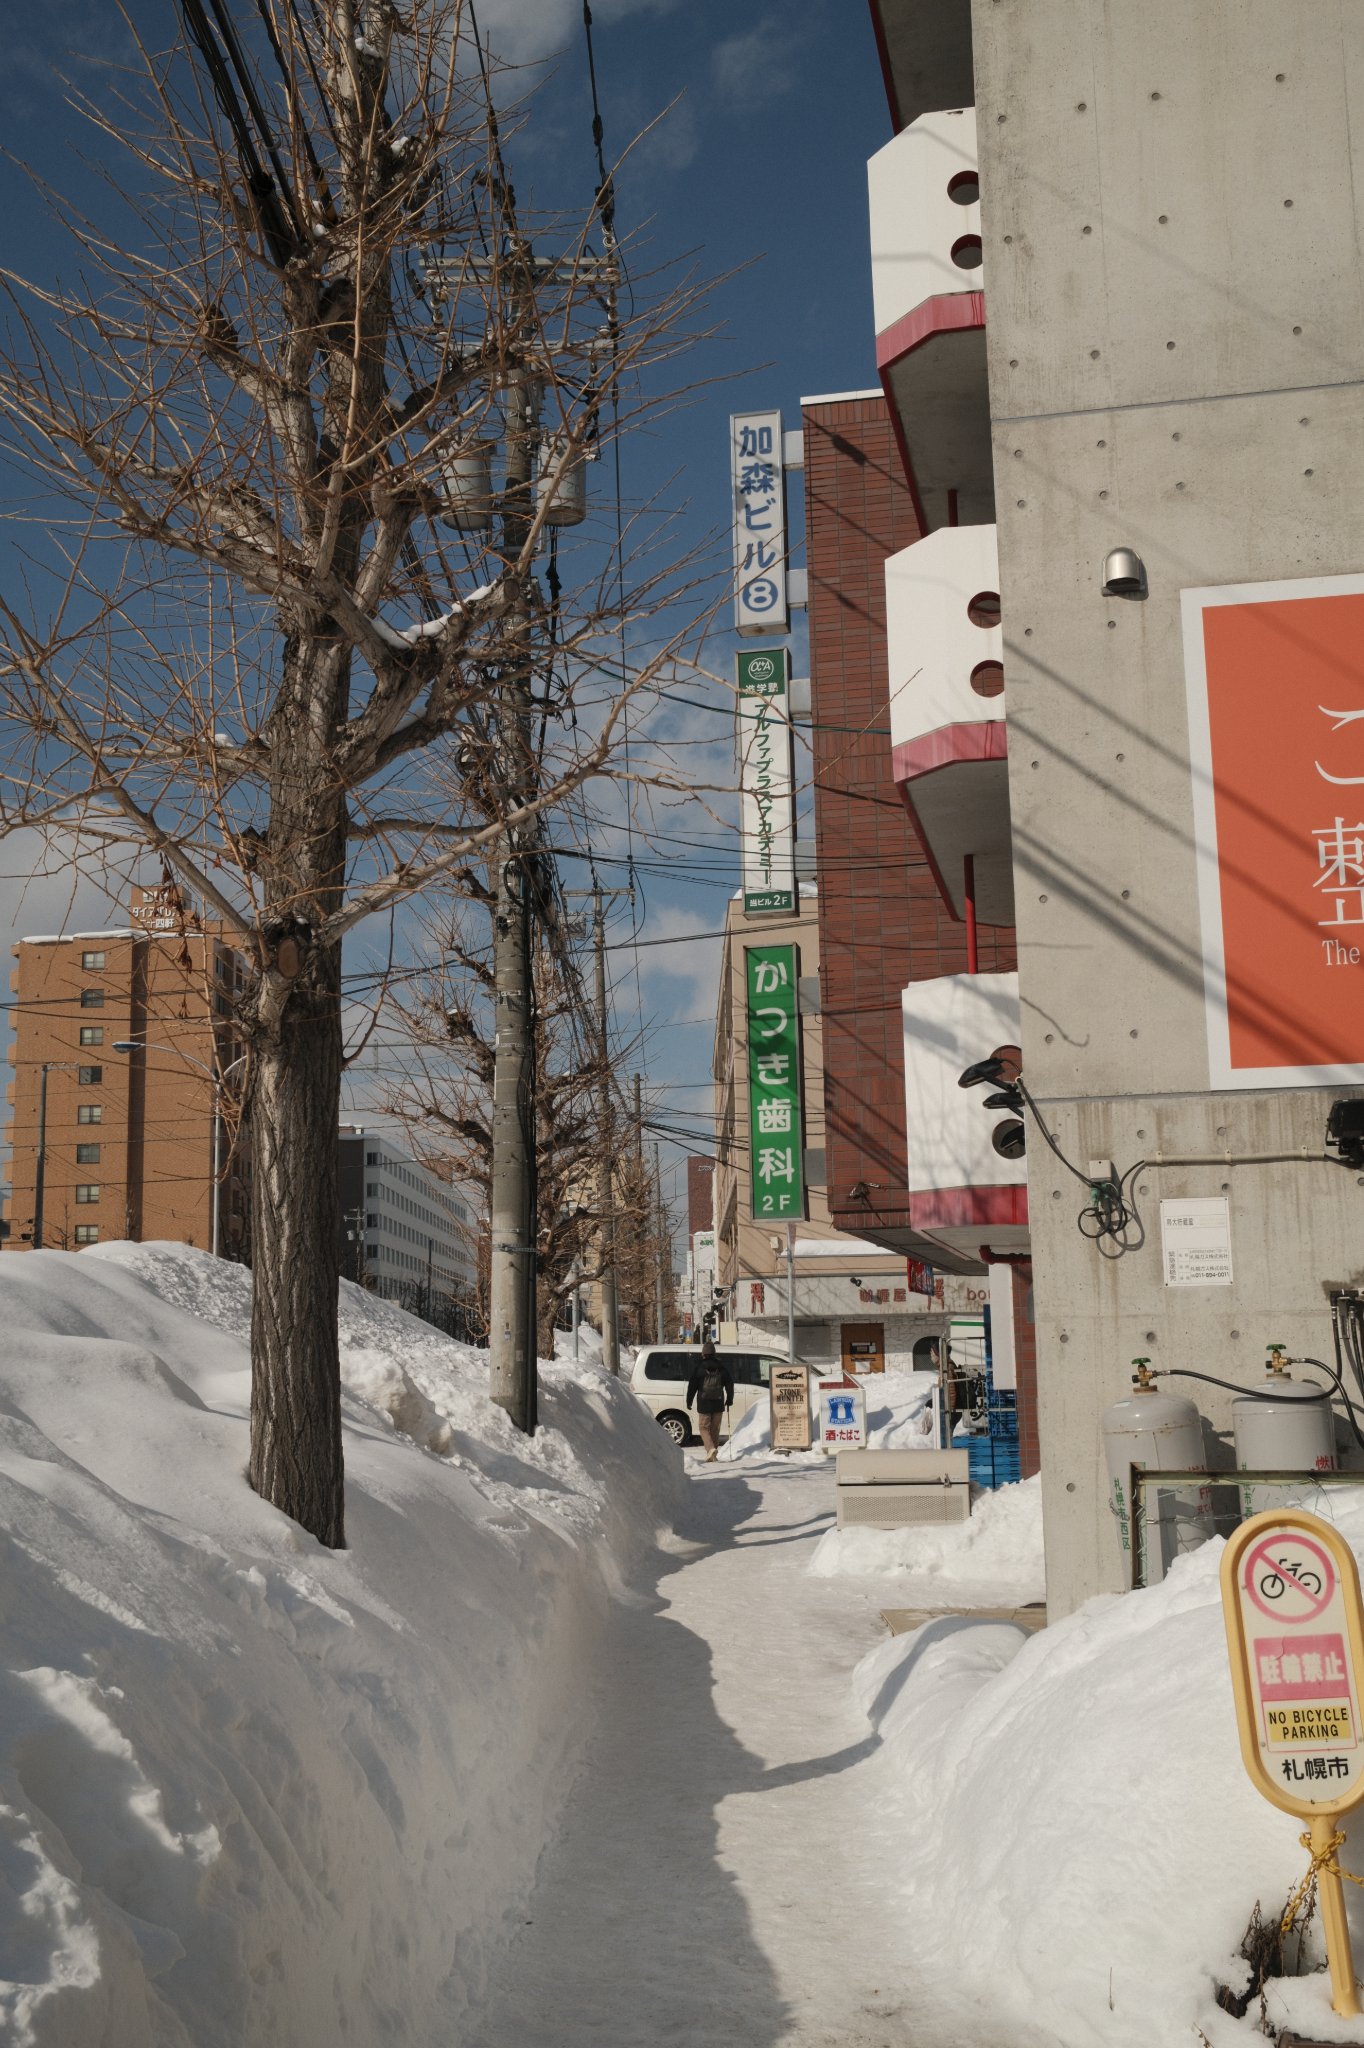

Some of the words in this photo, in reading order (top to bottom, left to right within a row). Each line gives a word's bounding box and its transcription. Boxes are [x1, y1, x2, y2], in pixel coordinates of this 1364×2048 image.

[754, 704, 774, 885] アルファプラスアカデミー
[137, 918, 175, 928] 二十四軒
[1322, 939, 1361, 967] The
[754, 960, 795, 1185] かつき歯科
[1260, 1651, 1345, 1684] 駐輪禁止
[1269, 1711, 1287, 1725] NO
[1293, 1707, 1349, 1724] BICYCLE
[1282, 1724, 1339, 1740] PARKING
[1281, 1756, 1350, 1781] 札幌市
